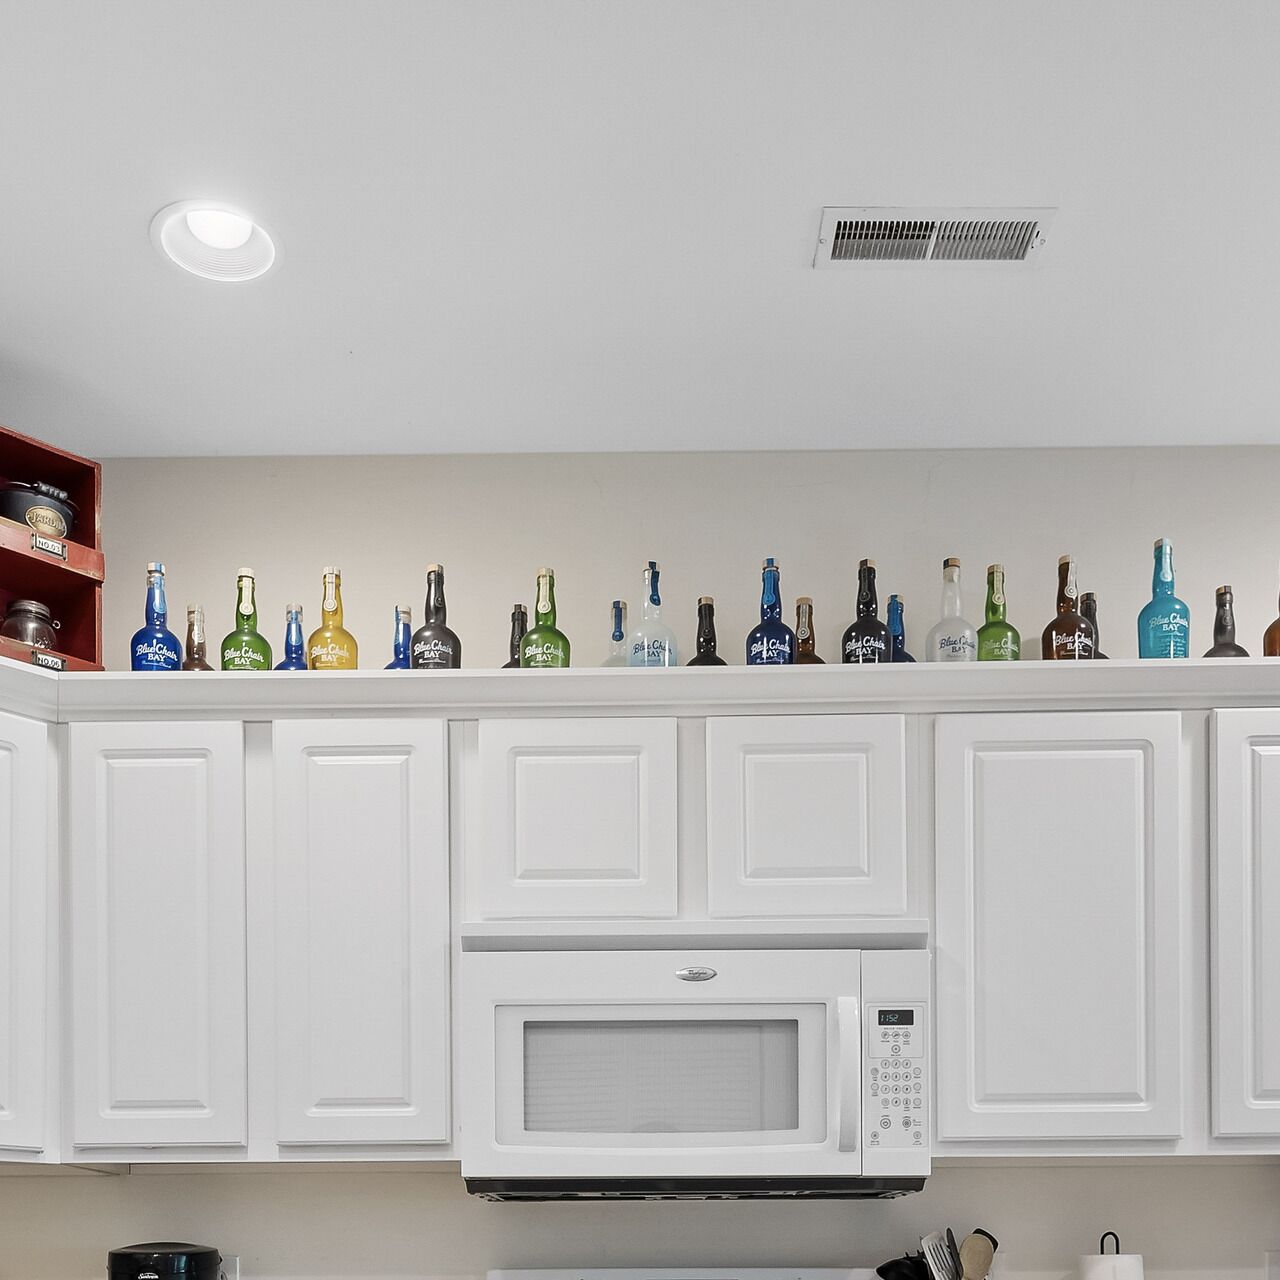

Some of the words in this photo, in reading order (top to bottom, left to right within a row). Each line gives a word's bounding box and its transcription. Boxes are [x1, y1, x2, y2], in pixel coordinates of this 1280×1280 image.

[31, 512, 66, 529] JARDIN
[37, 539, 61, 554] NO.03
[1149, 614, 1169, 629] Blue
[1162, 623, 1180, 631] BAY
[845, 640, 862, 654] Blue
[863, 636, 886, 650] Chair
[939, 635, 958, 649] Blue
[1055, 633, 1074, 646] Blue
[136, 642, 155, 657] Blue
[156, 643, 178, 662] Chair
[224, 648, 241, 662] Blue
[241, 647, 264, 663] Chair
[311, 645, 328, 659] Blue
[413, 641, 431, 656] Blue
[431, 640, 453, 655] Chair
[525, 643, 543, 659] Blue
[543, 643, 565, 658] Chair
[855, 647, 874, 655] BAY
[37, 657, 60, 669] NO.06
[148, 654, 166, 662] BAY
[234, 657, 251, 665] BAY
[321, 654, 338, 662] BAY
